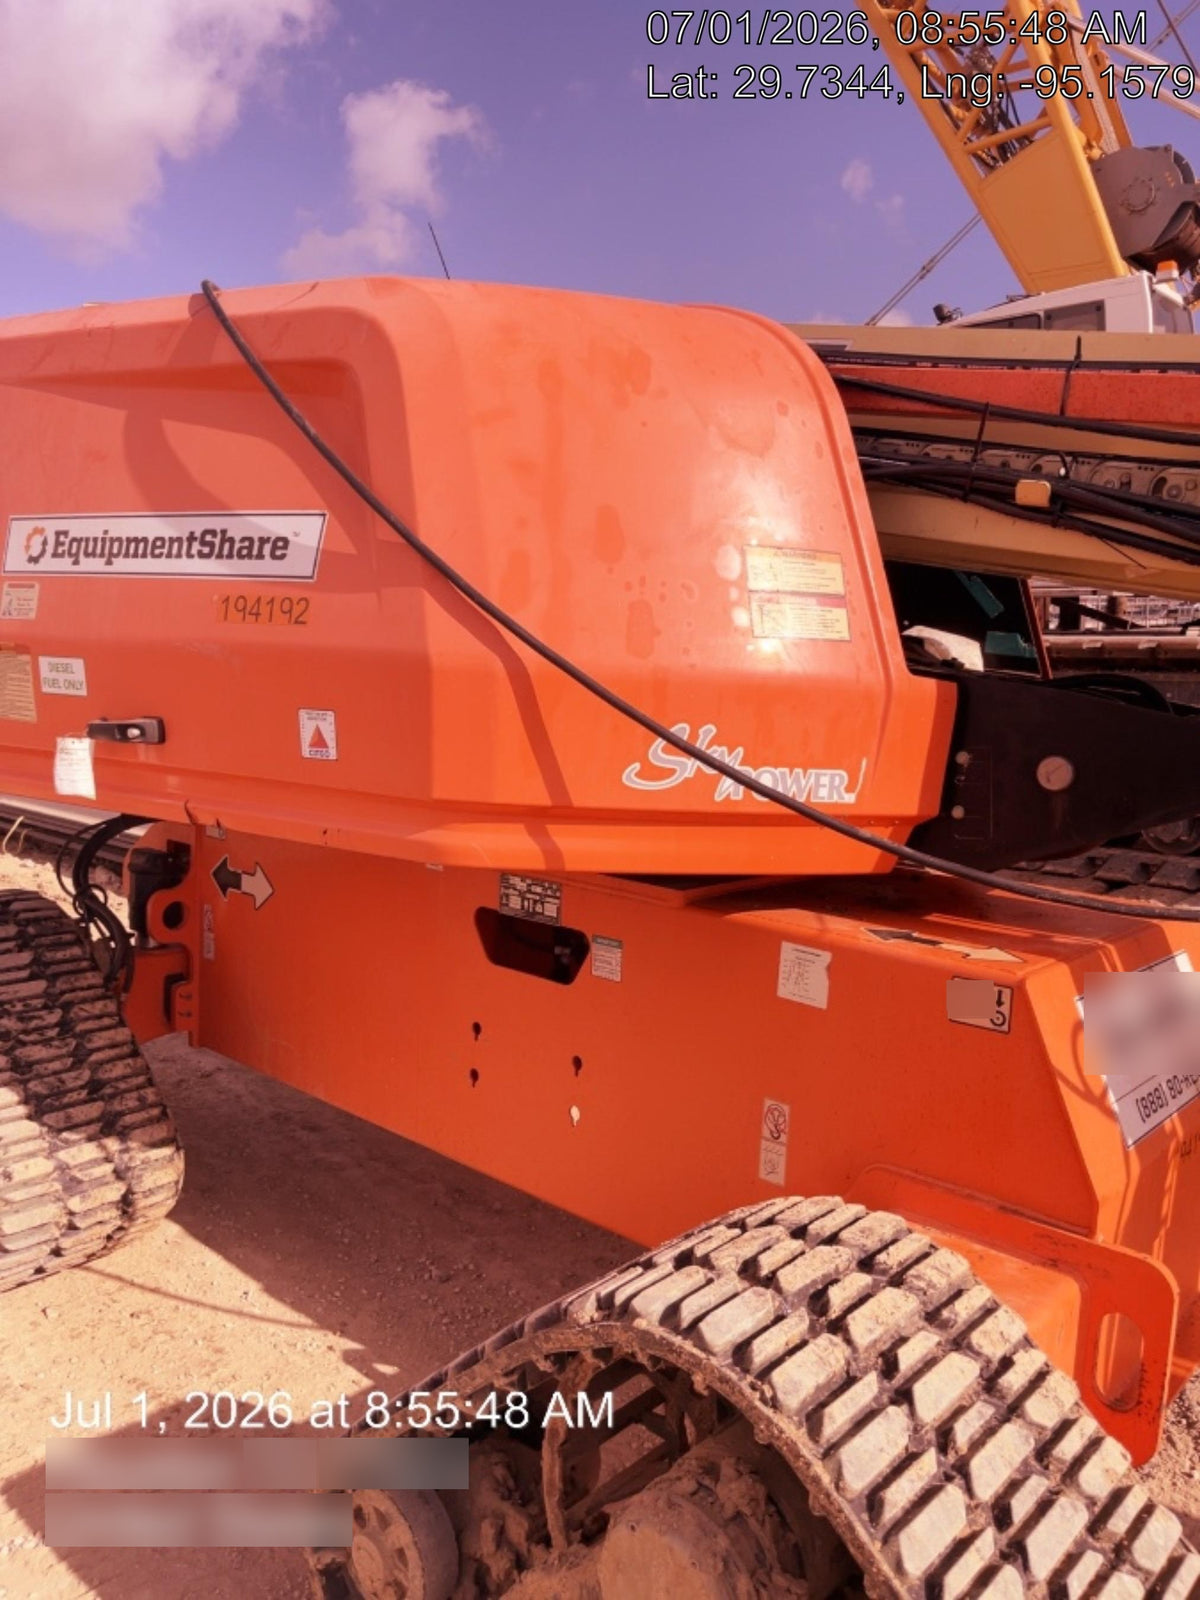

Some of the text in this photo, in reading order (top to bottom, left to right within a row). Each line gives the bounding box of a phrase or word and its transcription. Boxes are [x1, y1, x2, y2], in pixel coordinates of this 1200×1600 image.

[221, 595, 310, 625] 194192
[48, 661, 75, 675] DIESEL
[42, 676, 84, 692] FUEL ONLY
[1135, 1083, 1169, 1124] (888)
